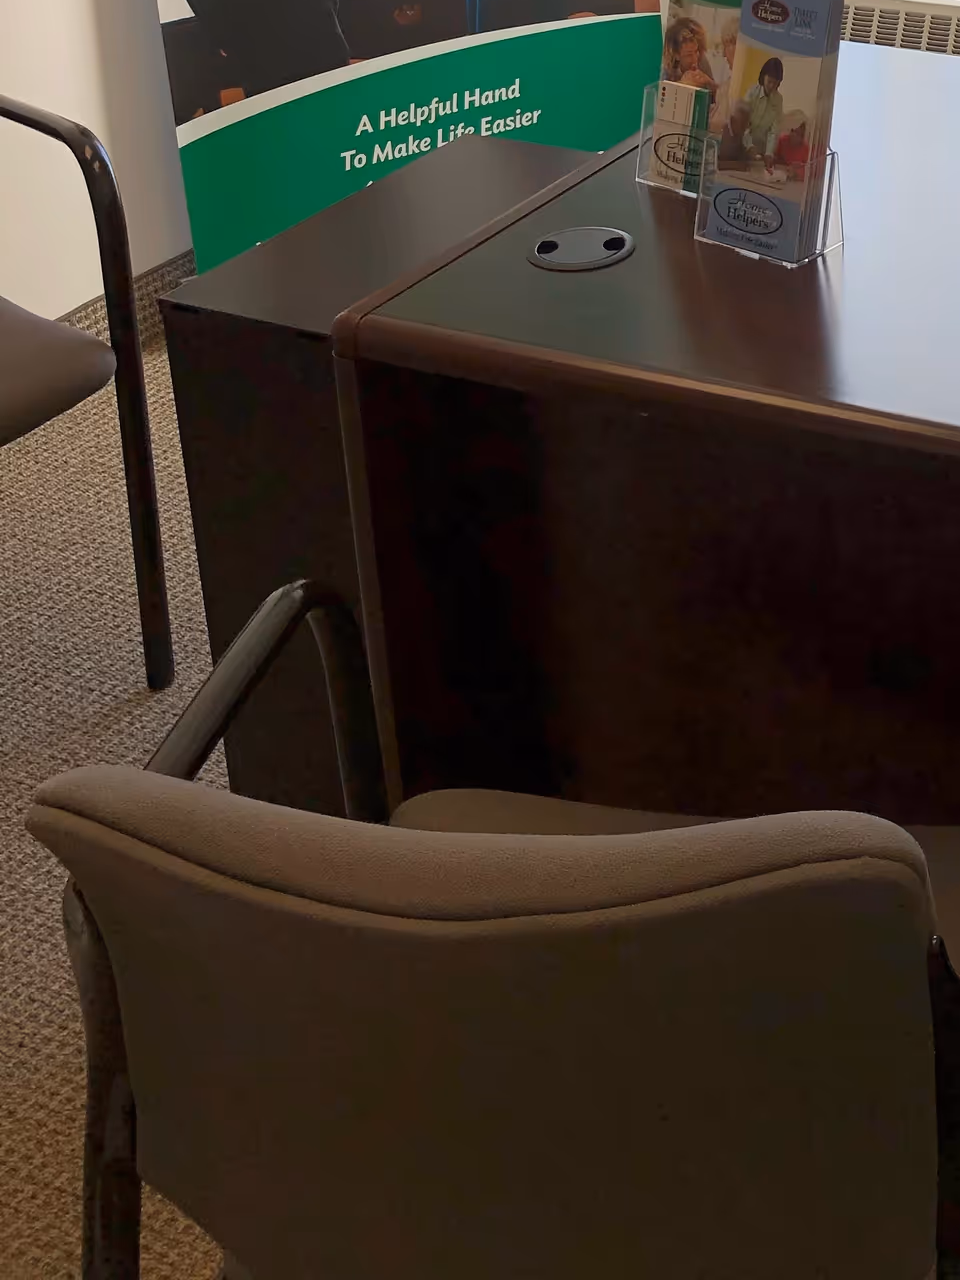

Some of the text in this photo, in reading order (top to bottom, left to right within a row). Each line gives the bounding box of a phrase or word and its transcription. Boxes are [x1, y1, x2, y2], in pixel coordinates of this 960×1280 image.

[355, 77, 521, 137] A Helpful Hand
[340, 148, 367, 171] To
[372, 132, 432, 164] Make
[480, 108, 542, 137] Easier
[726, 206, 770, 229] Helpers
